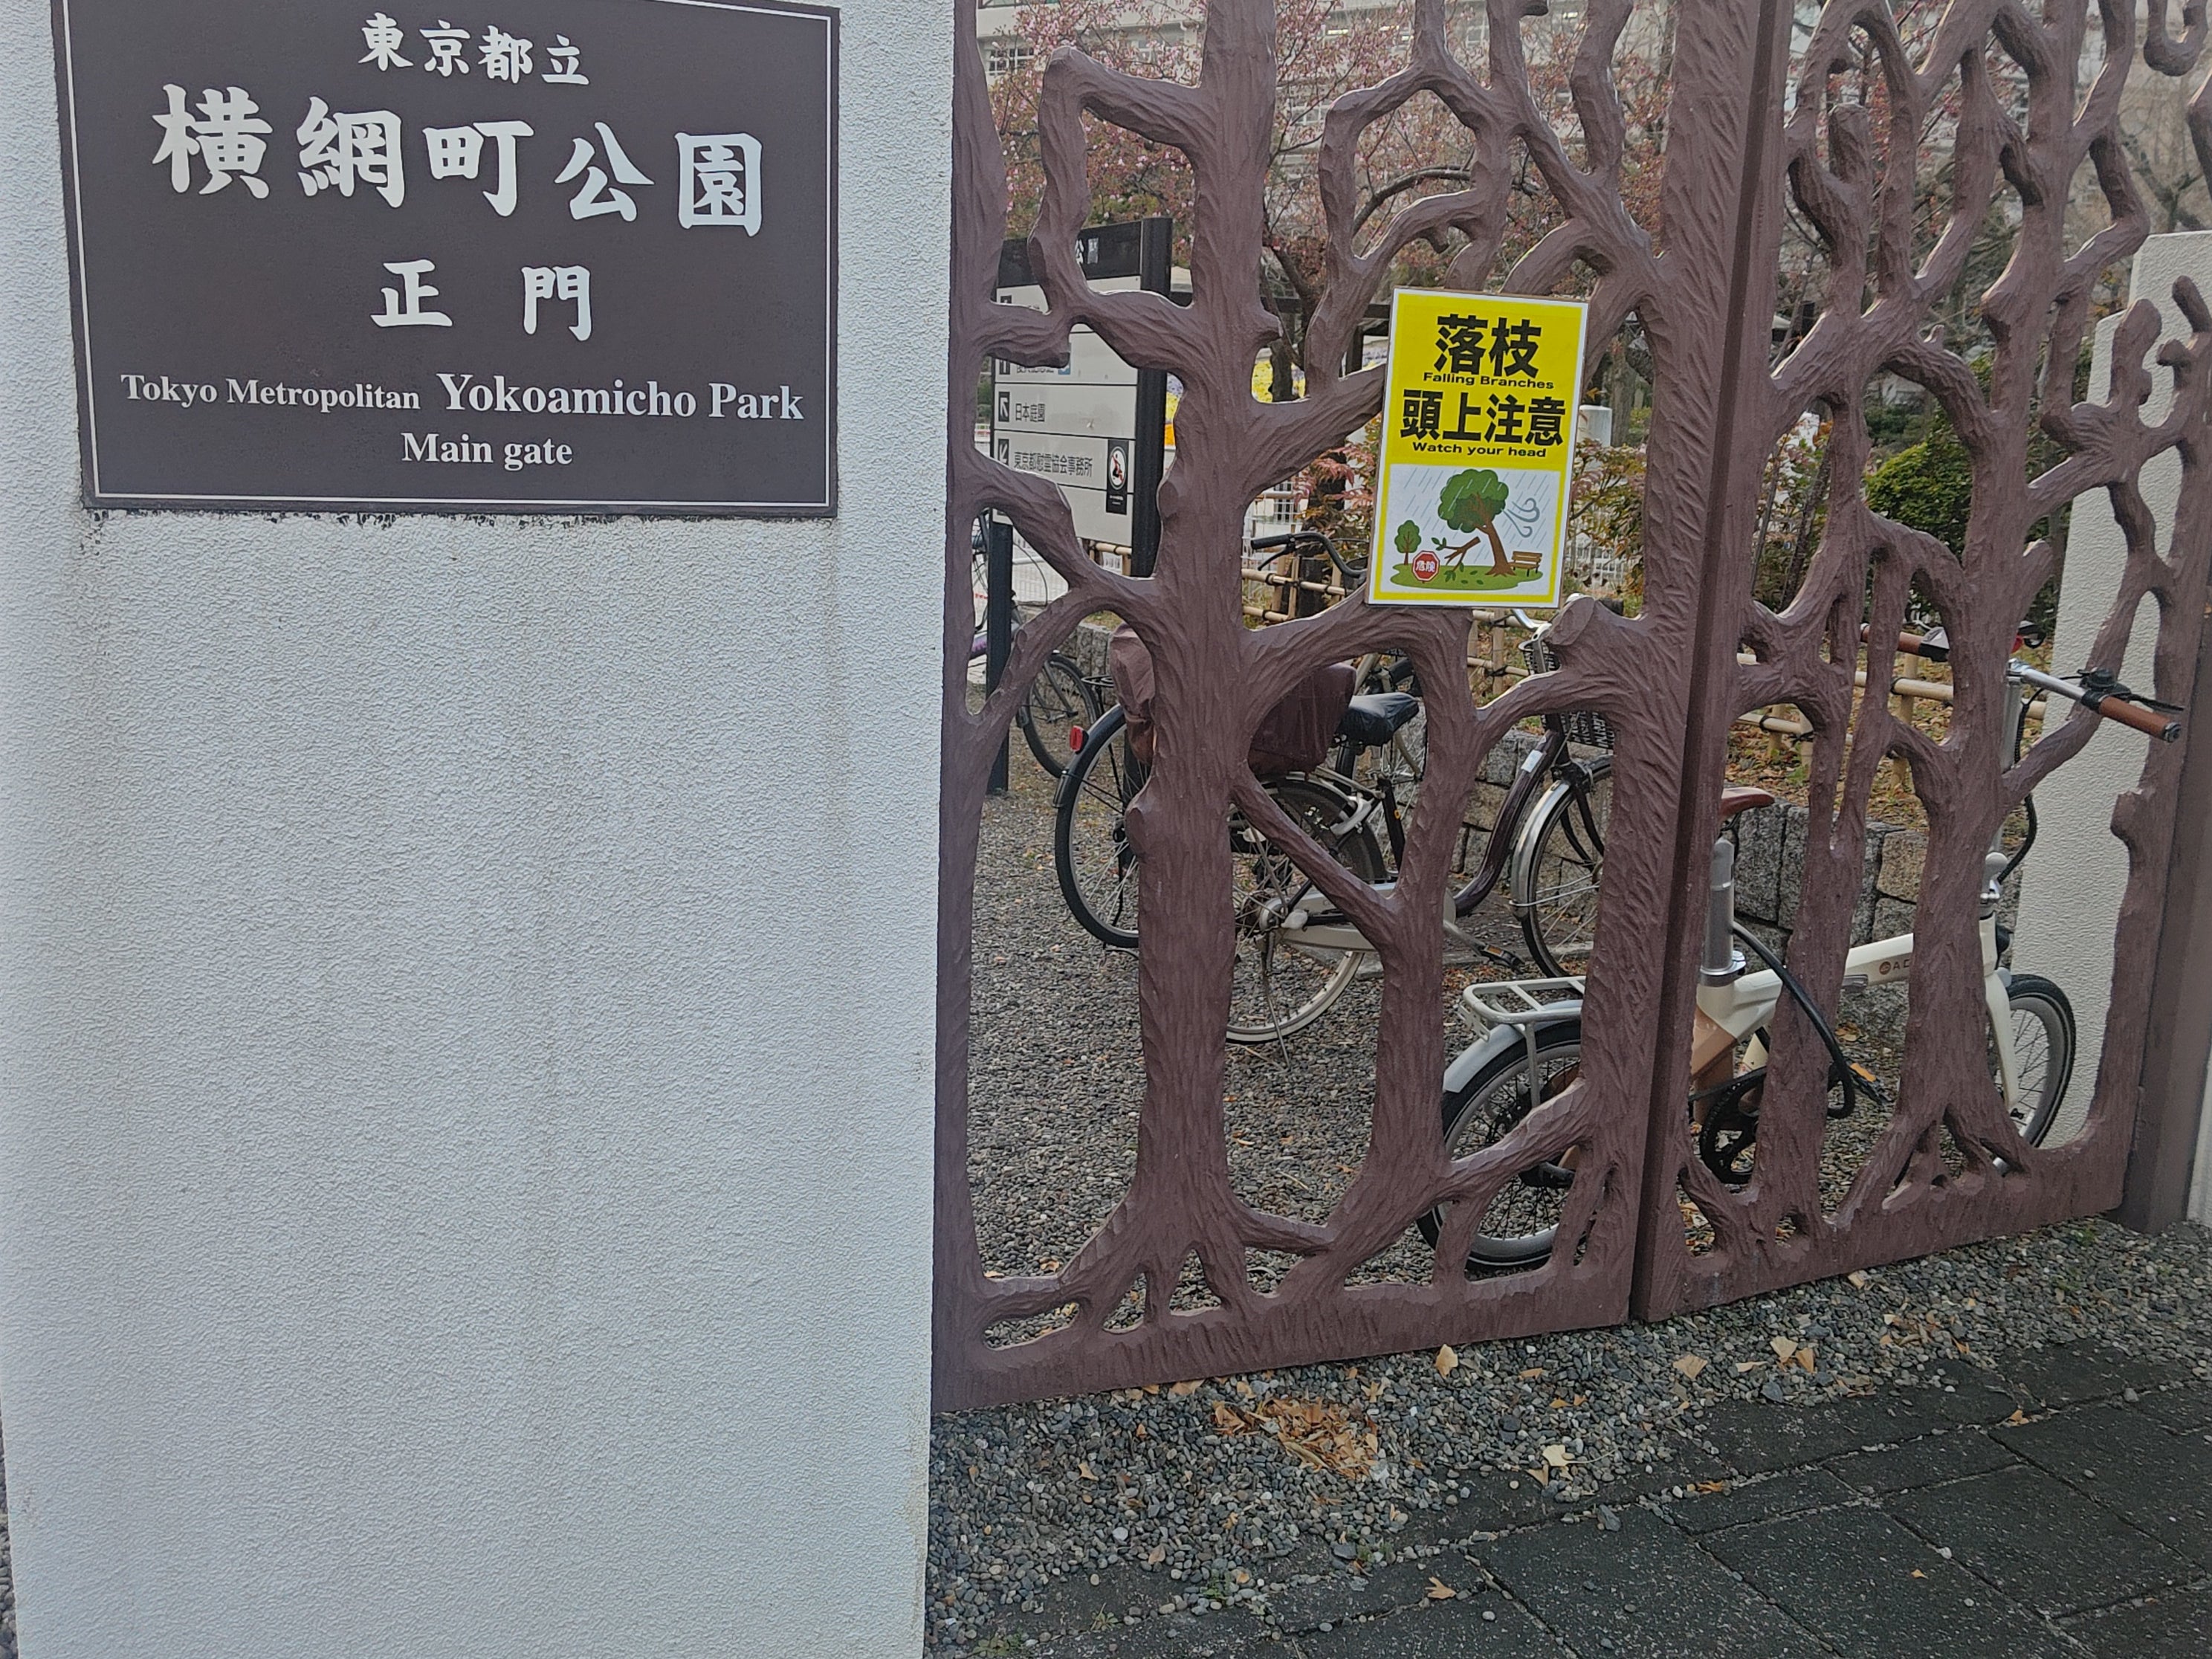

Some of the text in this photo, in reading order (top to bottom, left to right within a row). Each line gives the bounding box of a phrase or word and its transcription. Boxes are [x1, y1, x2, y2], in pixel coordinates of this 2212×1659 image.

[358, 13, 589, 85] 東京都立
[152, 83, 763, 237] 横網町公園
[1433, 313, 1542, 378] 落枝
[120, 373, 804, 420] Tokyo Metropolitan Yokoamicho Park
[1423, 372, 1554, 389] Falling Branches
[1015, 403, 1045, 423] 日本庭園
[1400, 388, 1566, 447] 頭上注意
[401, 433, 572, 471] Main gate
[1412, 442, 1547, 458] Watch your head
